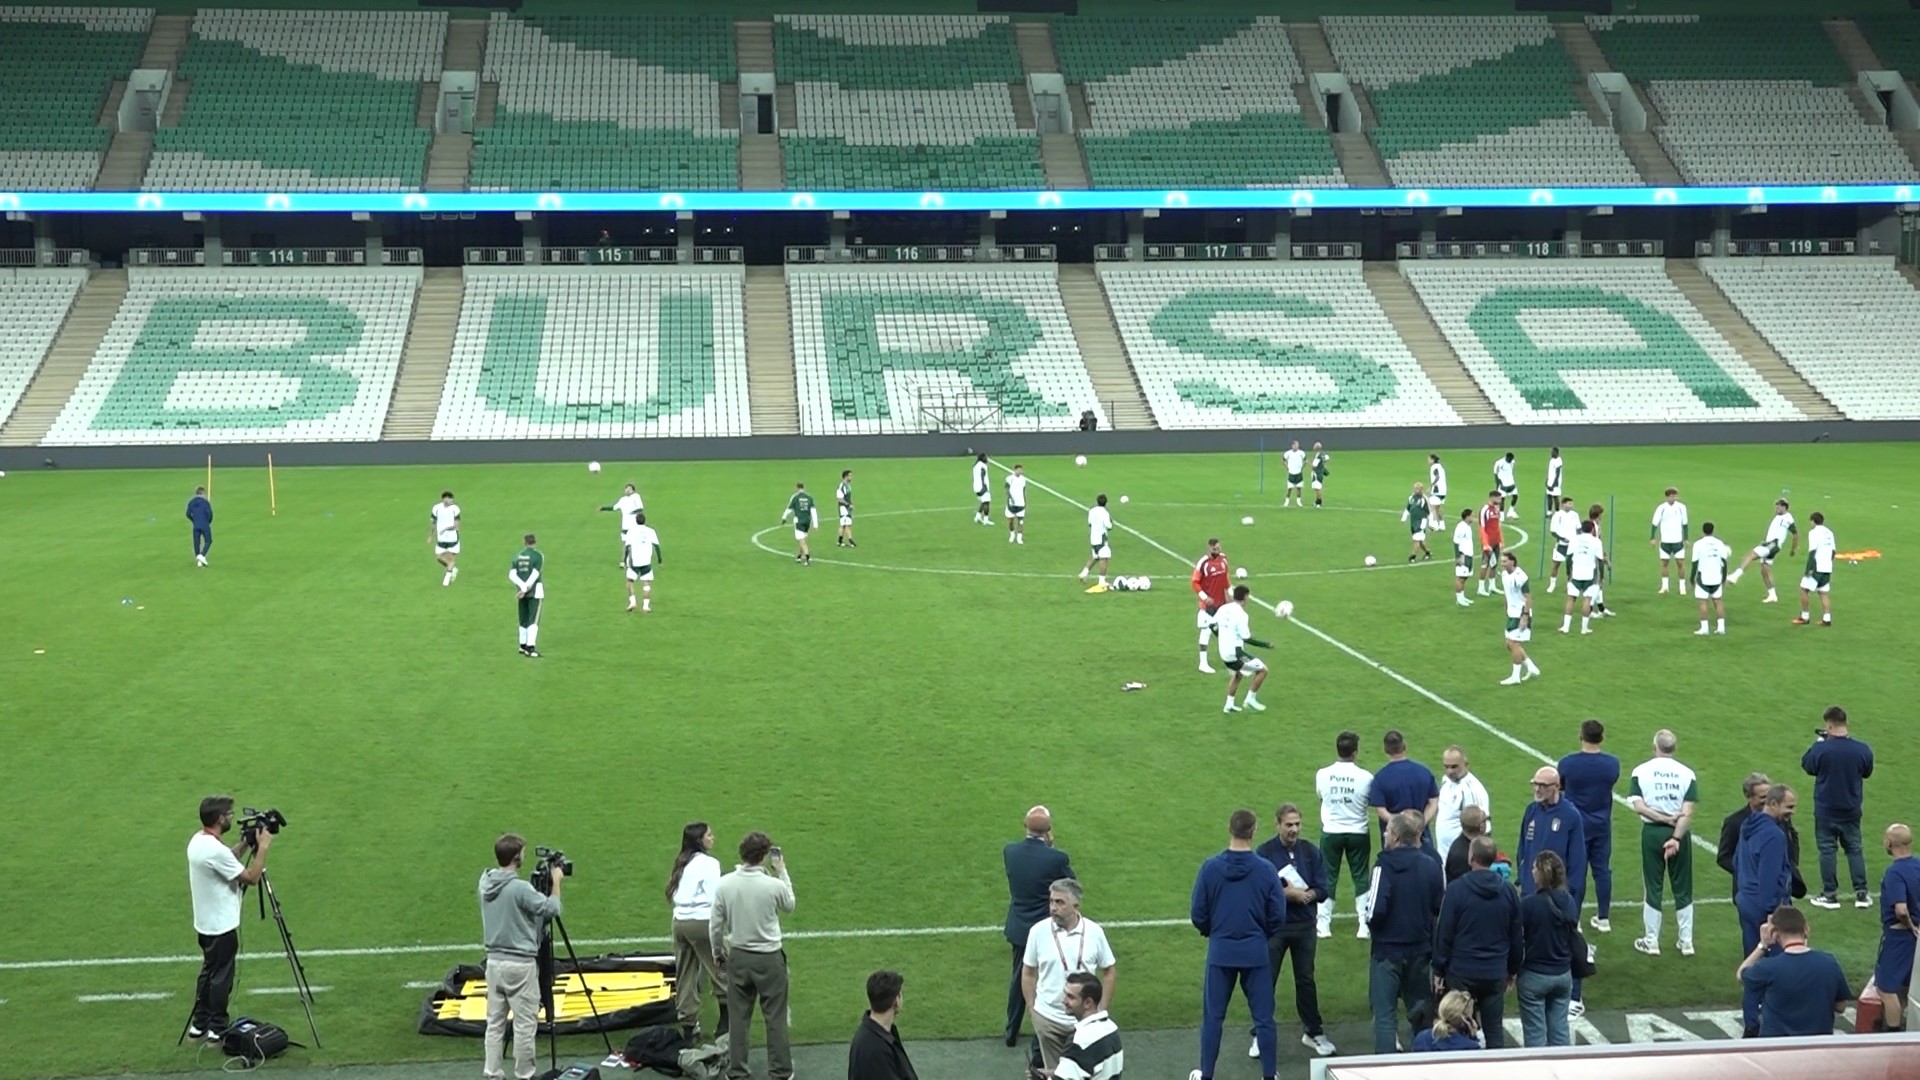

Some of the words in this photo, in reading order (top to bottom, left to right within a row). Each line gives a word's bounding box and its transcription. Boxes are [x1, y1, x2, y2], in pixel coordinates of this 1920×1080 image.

[895, 246, 919, 260] 116
[1205, 244, 1228, 258] 117
[1526, 241, 1549, 256] 118
[1790, 239, 1812, 253] 119
[269, 249, 294, 263] 114
[598, 248, 622, 262] 115
[88, 284, 1760, 431] BURSA
